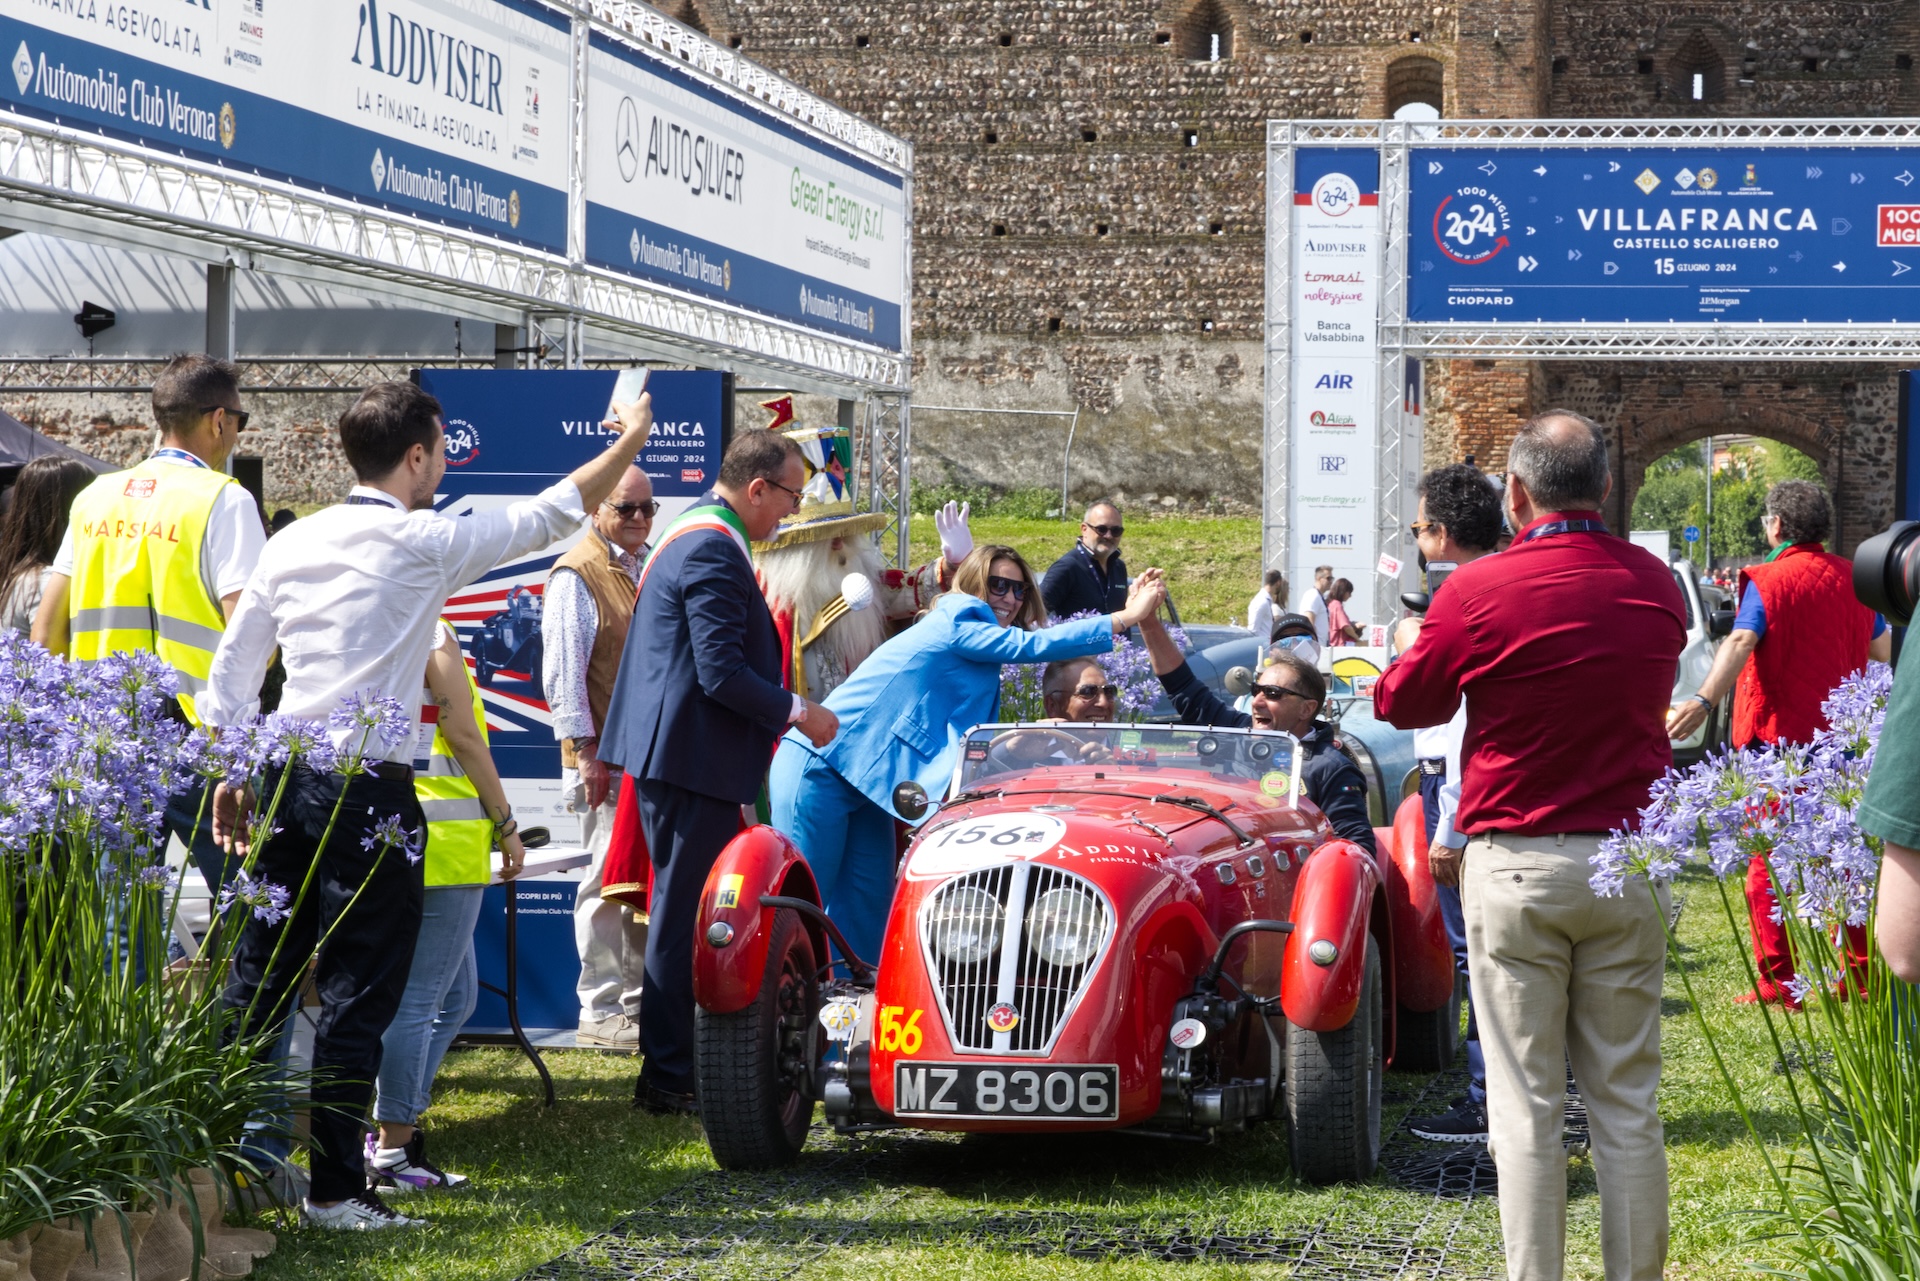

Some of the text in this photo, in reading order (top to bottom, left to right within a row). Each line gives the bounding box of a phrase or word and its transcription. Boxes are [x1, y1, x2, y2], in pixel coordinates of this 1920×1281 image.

[105, 4, 202, 57] AGEVOLATA
[351, 0, 504, 116] ADDVISER
[35, 52, 216, 142] Automobile Club Verona
[356, 86, 498, 154] LA FINANZA AGEVOLATA
[645, 115, 744, 205] AUTOSILVER
[386, 156, 508, 222] Automobile Club Verona
[1323, 187, 1348, 207] 2024
[790, 166, 884, 242] Green Energy s.r.l.
[1457, 187, 1511, 231] 1000 MIGLIA
[1445, 204, 1497, 245] 2024
[1577, 208, 1818, 231] VILLAFRANCA
[1886, 209, 1920, 224] 100
[1304, 239, 1366, 252] ADDVISER
[1613, 238, 1779, 249] CASTELLO SCALIGERO
[640, 234, 722, 287] Automobile Club Verona
[1654, 258, 1737, 275] 15 GIUGNO 2024
[1304, 270, 1365, 283] tomasi
[1304, 287, 1363, 305] noleggiare
[1447, 296, 1514, 305] CHOPARD
[806, 288, 868, 331] Automobile Club Verona
[1317, 320, 1351, 330] Banca
[1304, 332, 1365, 342] Valsabbina
[466, 423, 480, 446] MIGLIA
[562, 420, 705, 437] VILLANCA
[443, 430, 472, 454] 2024
[654, 440, 705, 448] SCALIGERO
[646, 454, 679, 463] GIUGNO
[683, 454, 705, 463] 2024
[1319, 456, 1346, 472] B&P
[132, 480, 153, 489] 1000
[1297, 495, 1321, 503] Green
[1322, 495, 1349, 504] Energy
[84, 519, 180, 543] MARSAL
[937, 825, 1028, 848] 156
[1090, 857, 1138, 865] FINANZA
[516, 892, 541, 900] SCOPRI
[551, 892, 562, 900] PIÙ
[879, 1005, 924, 1055] 156
[901, 1068, 1109, 1113] MZ 8306
